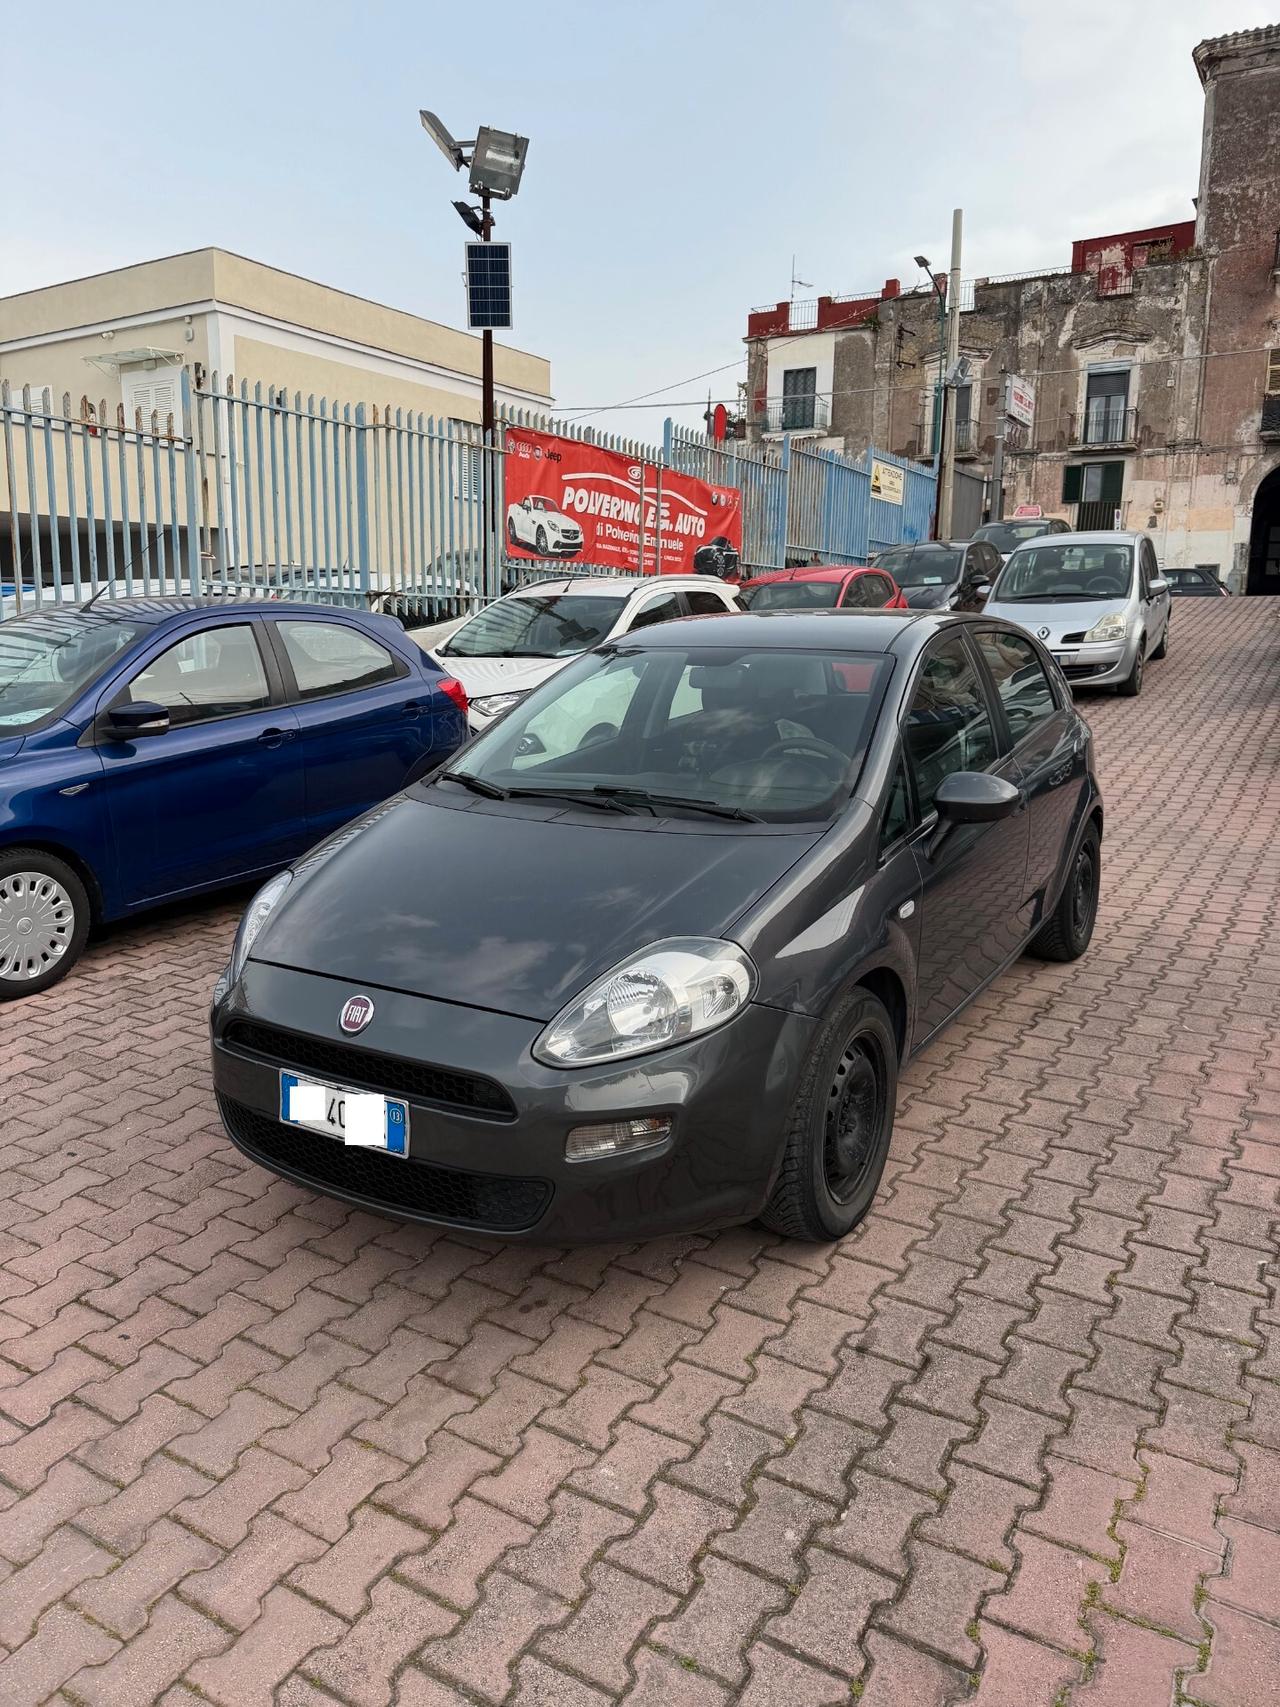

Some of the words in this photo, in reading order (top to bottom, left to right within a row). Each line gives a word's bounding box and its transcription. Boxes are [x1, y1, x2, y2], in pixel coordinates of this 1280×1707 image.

[544, 448, 562, 464] Jeep
[674, 512, 706, 538] AUTO
[346, 1005, 367, 1023] FIAT
[392, 1110, 400, 1121] 13
